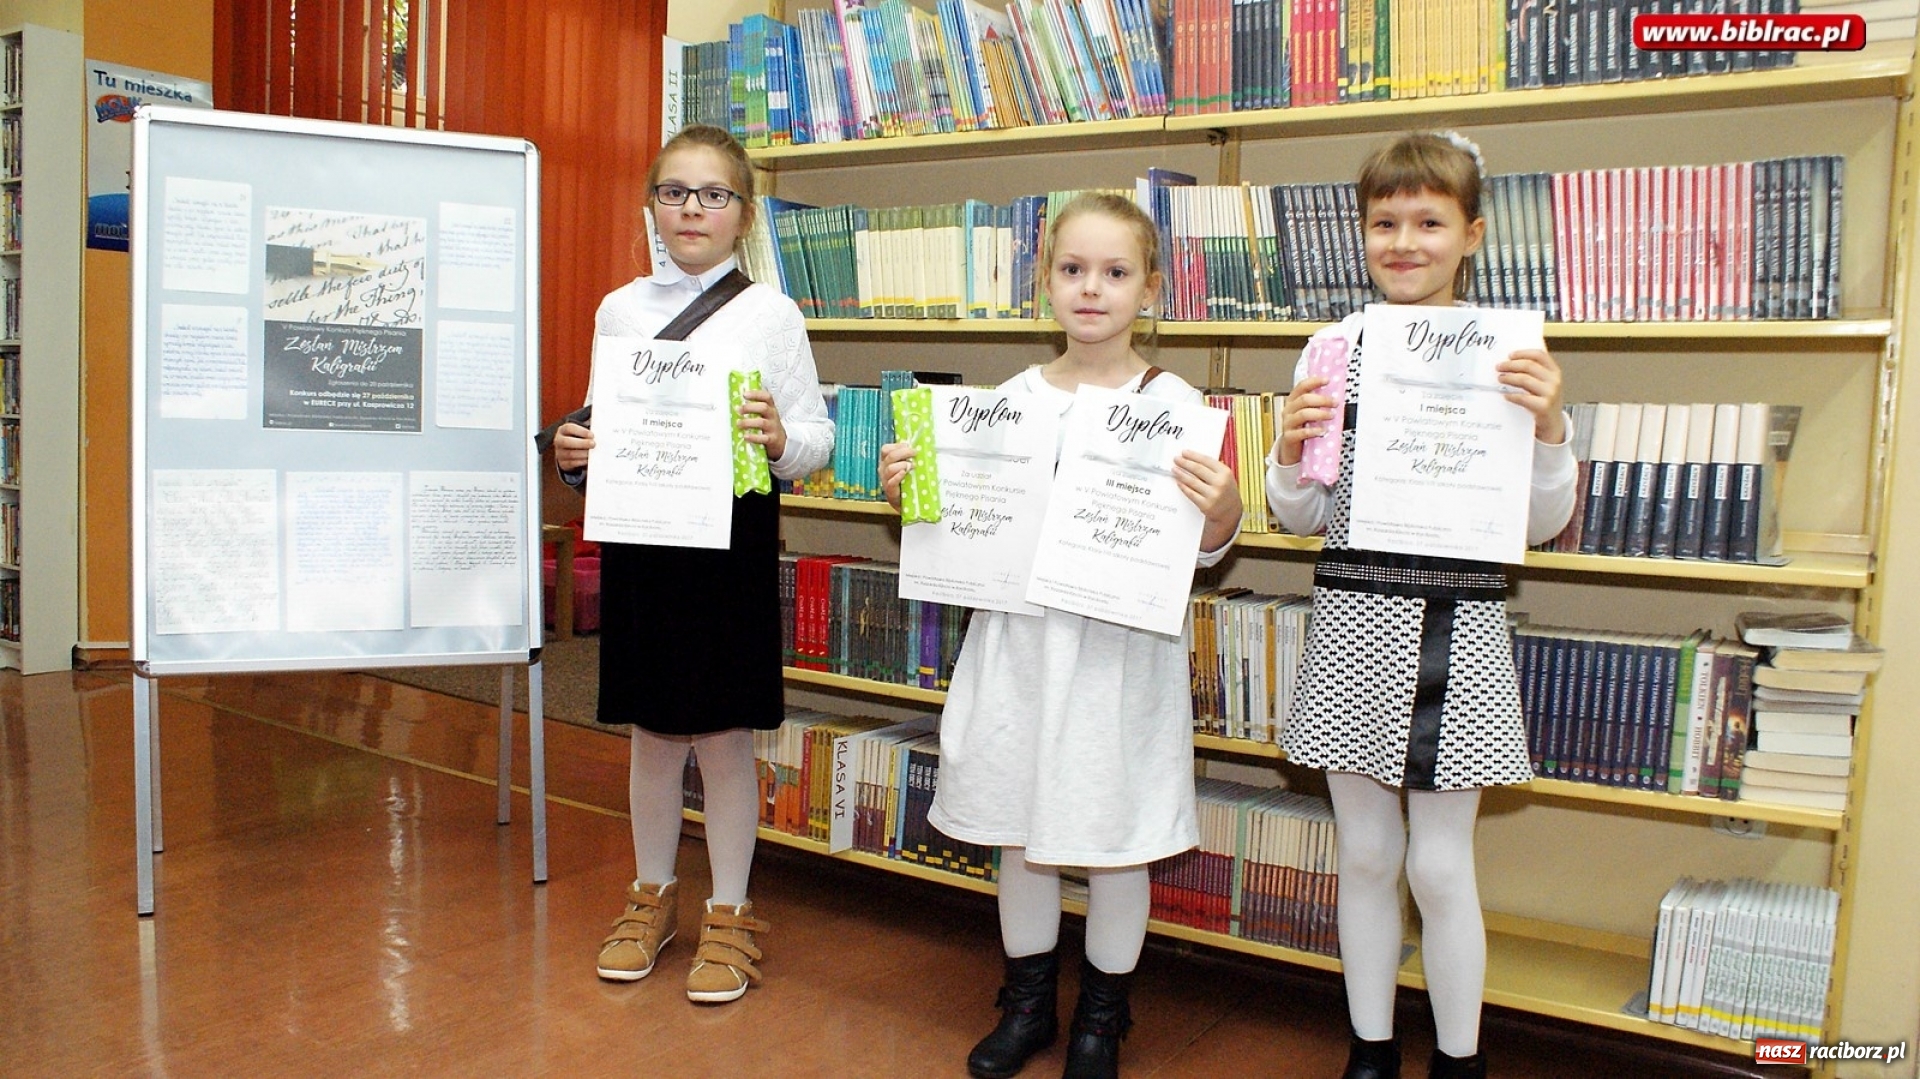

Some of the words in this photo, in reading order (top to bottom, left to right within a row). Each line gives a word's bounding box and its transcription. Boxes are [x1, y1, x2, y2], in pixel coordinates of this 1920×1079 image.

[94, 69, 116, 88] Tu
[124, 79, 193, 103] mieszka
[669, 70, 678, 87] II
[327, 325, 350, 333] Konkurs
[342, 337, 403, 362] Mistrzem
[1405, 320, 1498, 362] Dyplom
[311, 356, 378, 378] Kaligrafii
[631, 349, 706, 384] Dyplom
[290, 389, 317, 397] Konkurs
[949, 395, 1023, 433] Dyplom
[1426, 405, 1466, 415] miejsca
[650, 419, 683, 428] miejsca
[1106, 404, 1184, 443] Dyplom
[1434, 442, 1486, 463] Mistrzem
[1411, 458, 1467, 478] Kaligrafii
[943, 479, 990, 490] Powiatowym
[1106, 479, 1115, 487] III
[1116, 482, 1151, 495] miejsca
[941, 504, 963, 517] ostań
[970, 508, 1013, 527] Mistrzem
[951, 522, 998, 539] Kaligrafii
[1092, 528, 1142, 549] Kaligrafii
[1115, 517, 1160, 539] Mistrzem
[1697, 671, 1709, 709] TOLKIEN
[835, 740, 848, 795] KLASA
[834, 800, 846, 819] VI
